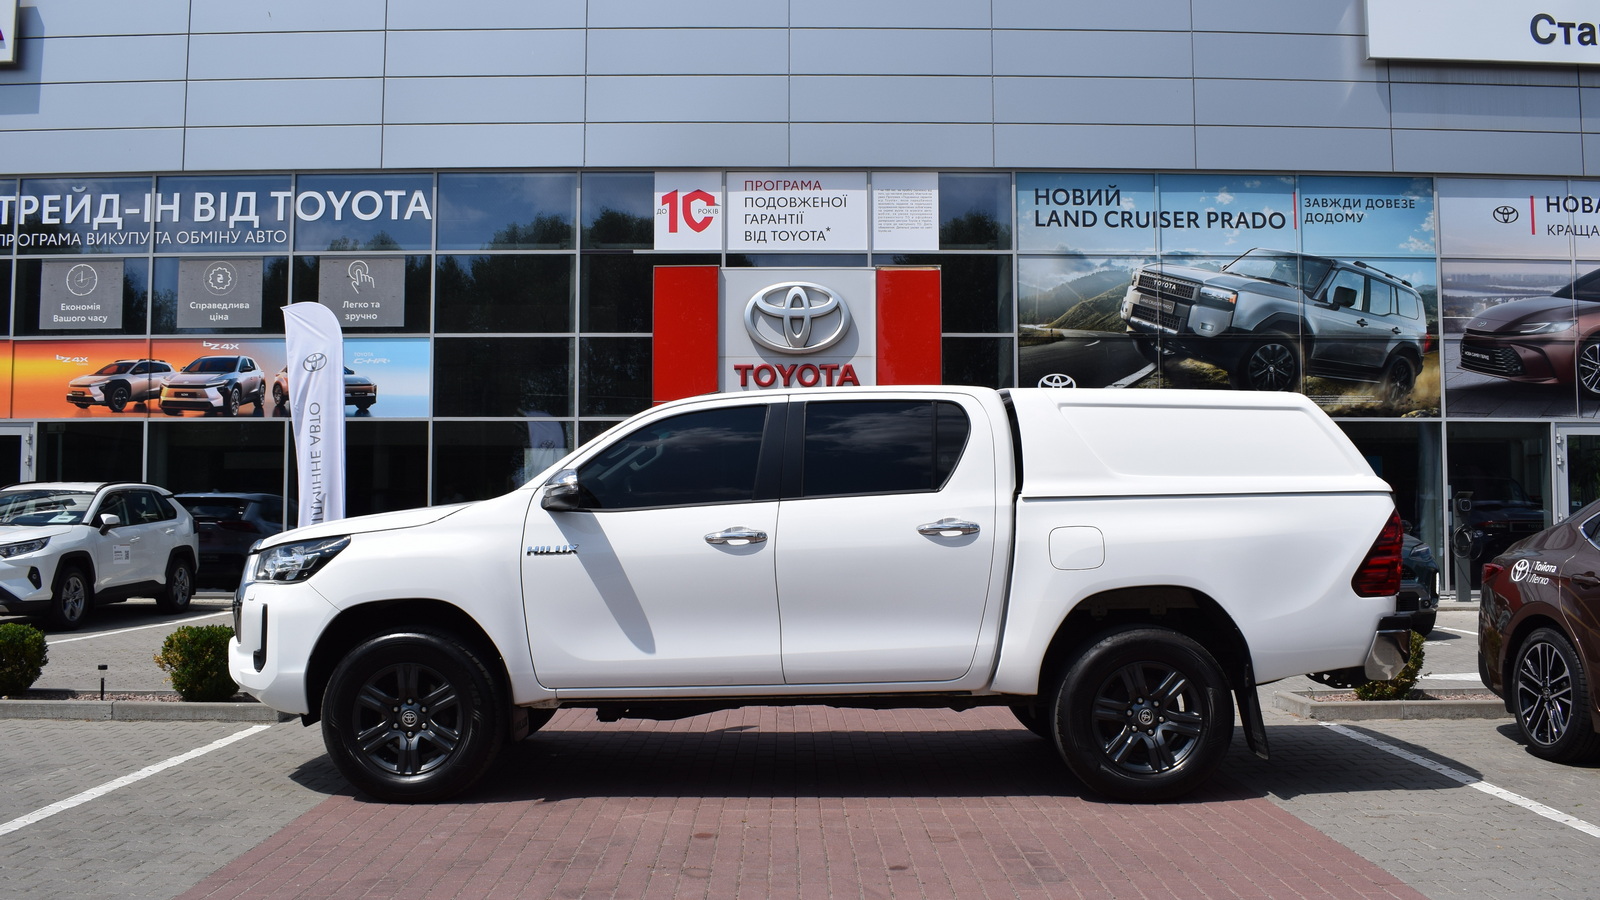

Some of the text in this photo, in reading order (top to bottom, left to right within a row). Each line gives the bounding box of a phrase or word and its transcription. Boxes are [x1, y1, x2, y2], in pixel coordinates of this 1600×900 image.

[1530, 13, 1600, 46] Ста
[744, 180, 823, 191] ПРОГРАМА
[1034, 184, 1121, 206] НОВИЙ
[0, 186, 433, 231] ТРЕЙД-ІН ВІД TOYOTA
[744, 194, 848, 210] ПОДОВЖЕНОЇ
[1304, 198, 1416, 210] ЗАВЖДИ ДОВЕЗЕ
[744, 211, 805, 225] ГАРАНТІЇ
[1035, 209, 1287, 229] LAND CRUISER PRADO
[1304, 212, 1365, 225] ДОДОМУ
[86, 231, 151, 246] ВИКУПУ
[155, 231, 172, 244] ТА
[176, 230, 241, 244] ОБМІНУ
[244, 230, 287, 243] АВТО
[744, 230, 768, 244] ВІД
[1547, 224, 1600, 239] КРАЩА
[60, 302, 101, 311] Економія
[189, 301, 250, 311] Справедлива
[342, 300, 369, 309] Легко
[53, 314, 108, 324] Вашого часу
[209, 312, 229, 322] ціна
[344, 312, 378, 322] зручно
[733, 363, 861, 388] TOYOTA
[527, 543, 580, 557] HILUX
[1535, 561, 1556, 572] Тойота
[1529, 574, 1549, 585] Легко
